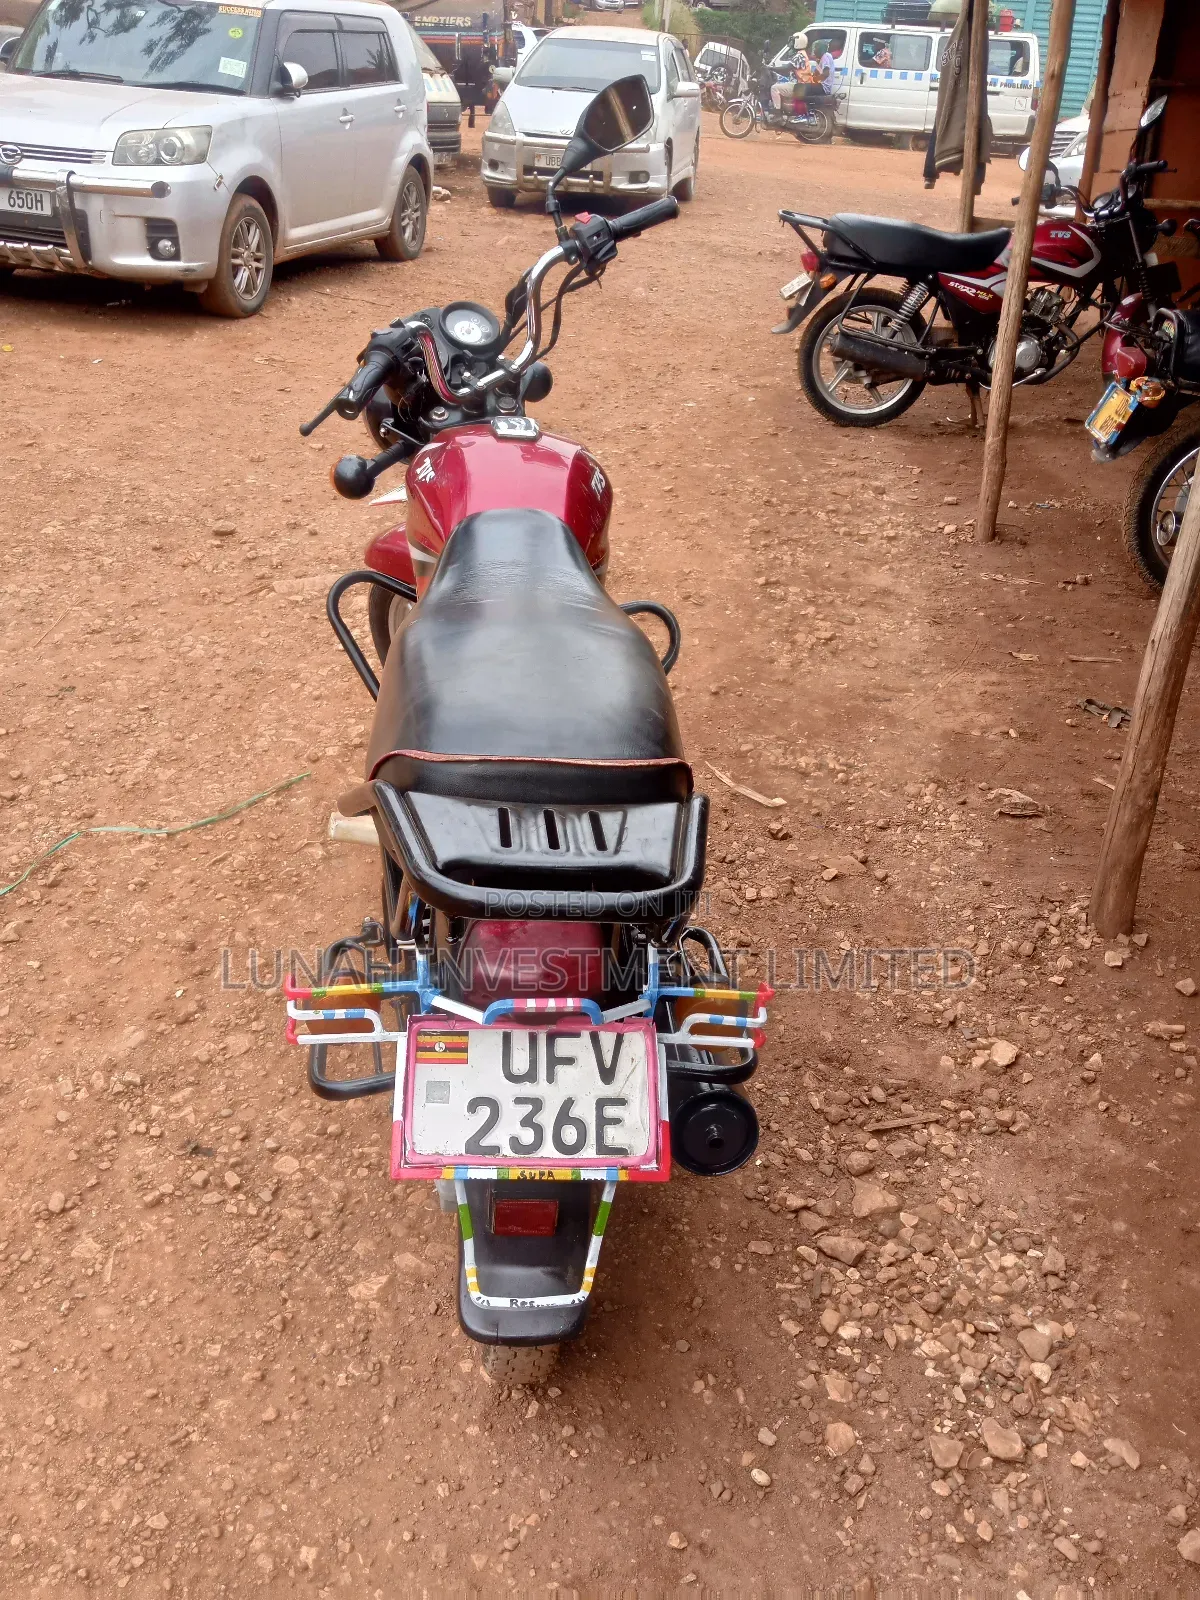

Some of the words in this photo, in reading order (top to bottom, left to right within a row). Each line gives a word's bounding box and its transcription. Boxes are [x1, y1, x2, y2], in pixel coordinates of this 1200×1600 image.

[414, 15, 472, 28] EMPTIERS
[999, 81, 1033, 90] PROBLEMS
[8, 189, 44, 212] 650H
[1049, 230, 1072, 239] TVS
[501, 1031, 625, 1086] UFV
[464, 1096, 631, 1156] 236E
[516, 1170, 556, 1180] SUPA
